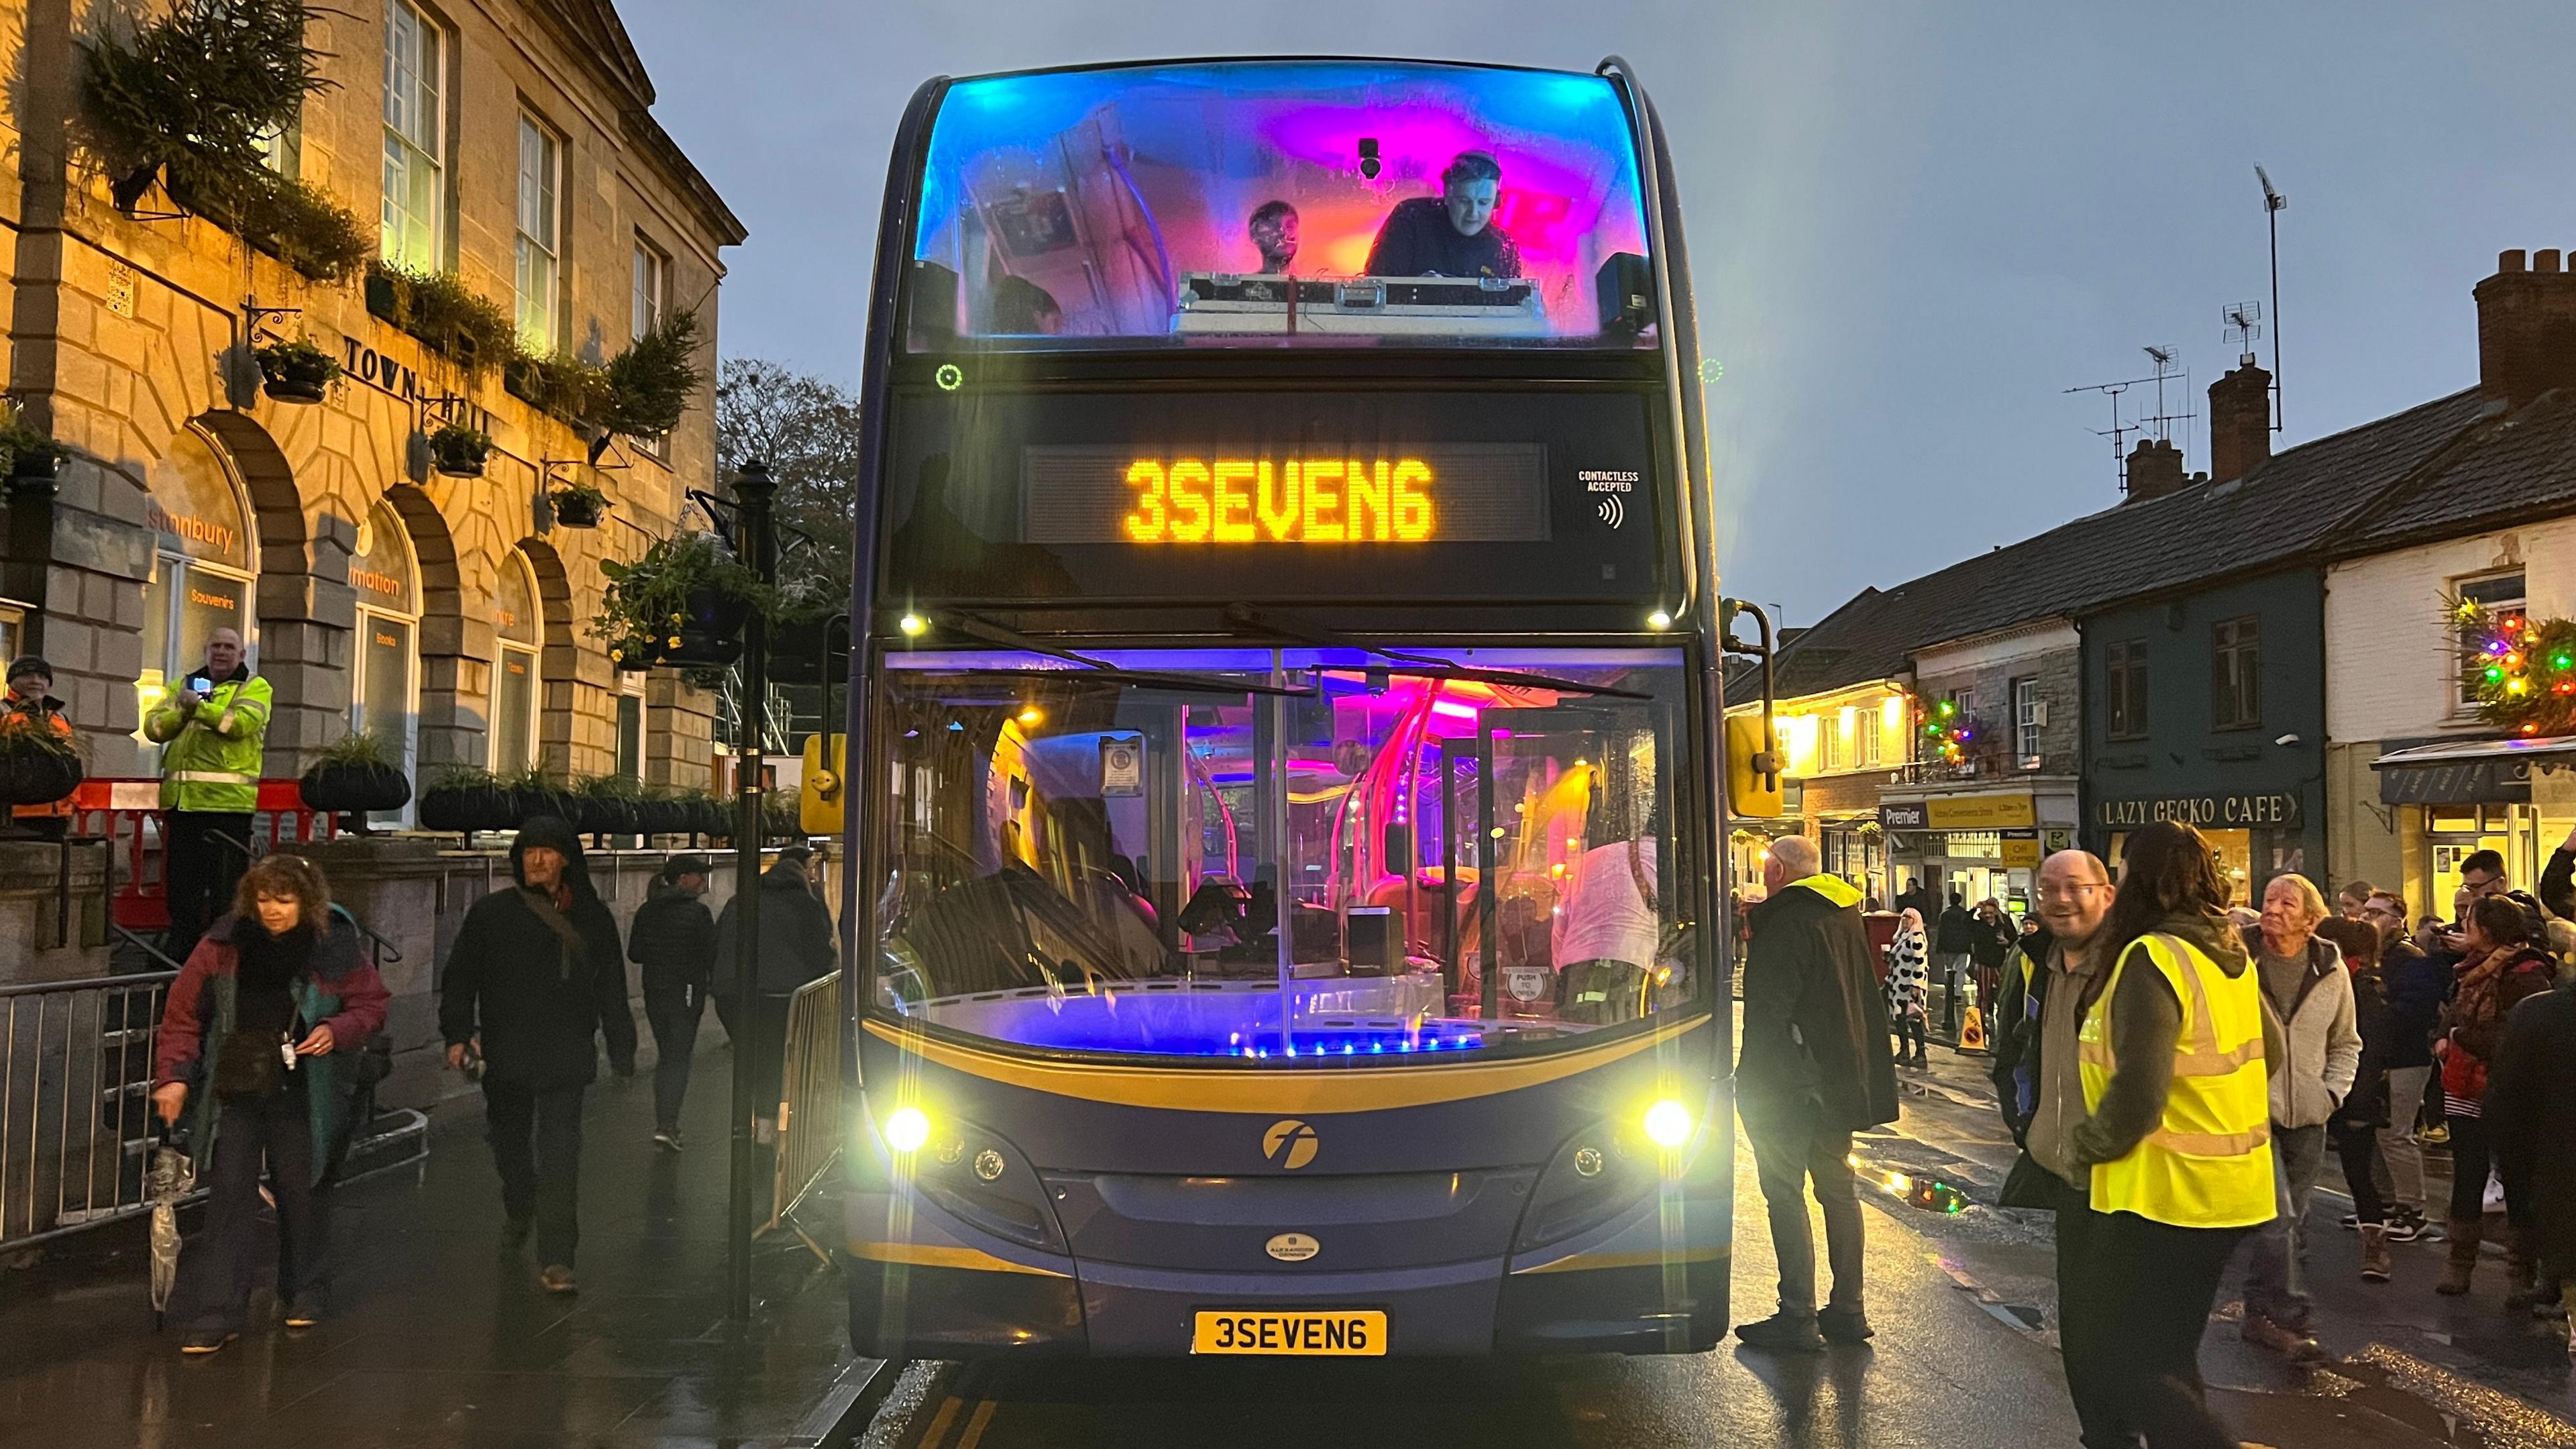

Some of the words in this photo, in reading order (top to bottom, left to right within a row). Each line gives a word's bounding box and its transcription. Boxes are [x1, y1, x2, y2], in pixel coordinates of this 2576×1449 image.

[343, 336, 416, 402] TOWN
[1578, 471, 1639, 482] CONTACTLESS
[1587, 482, 1631, 492] ACCEPTED
[1124, 459, 1433, 541] 3SEVEN6
[191, 589, 234, 610] Souvenirs
[1886, 809, 1920, 825] Premier
[2106, 801, 2147, 824] LAZY
[2154, 798, 2214, 824] GECKO
[2224, 796, 2282, 822] CAFE
[1216, 1318, 1366, 1350] 3SEVEN6
